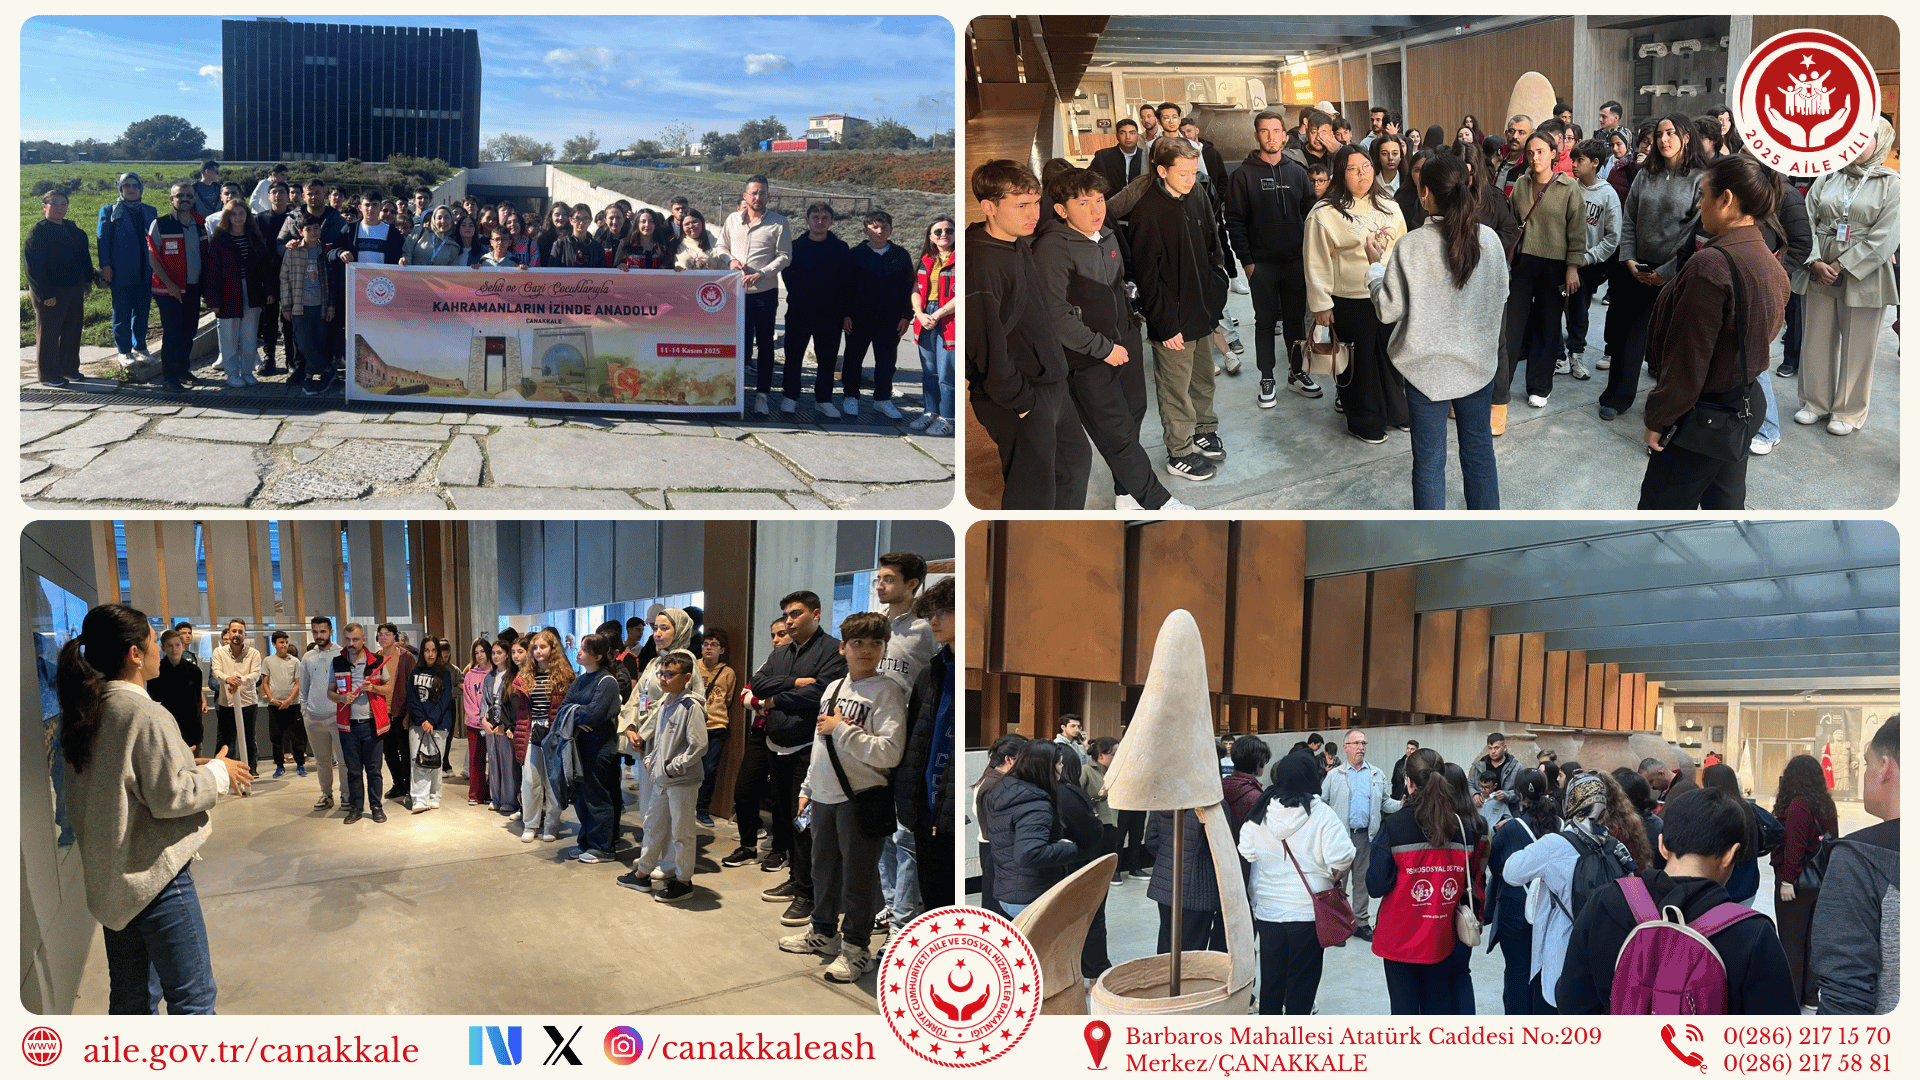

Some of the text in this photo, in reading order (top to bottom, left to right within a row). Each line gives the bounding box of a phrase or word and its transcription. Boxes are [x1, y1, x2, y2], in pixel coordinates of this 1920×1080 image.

[432, 301, 658, 316] KAHRAMANLARIN İZİNDE ANADOLU
[704, 347, 721, 355] 2025
